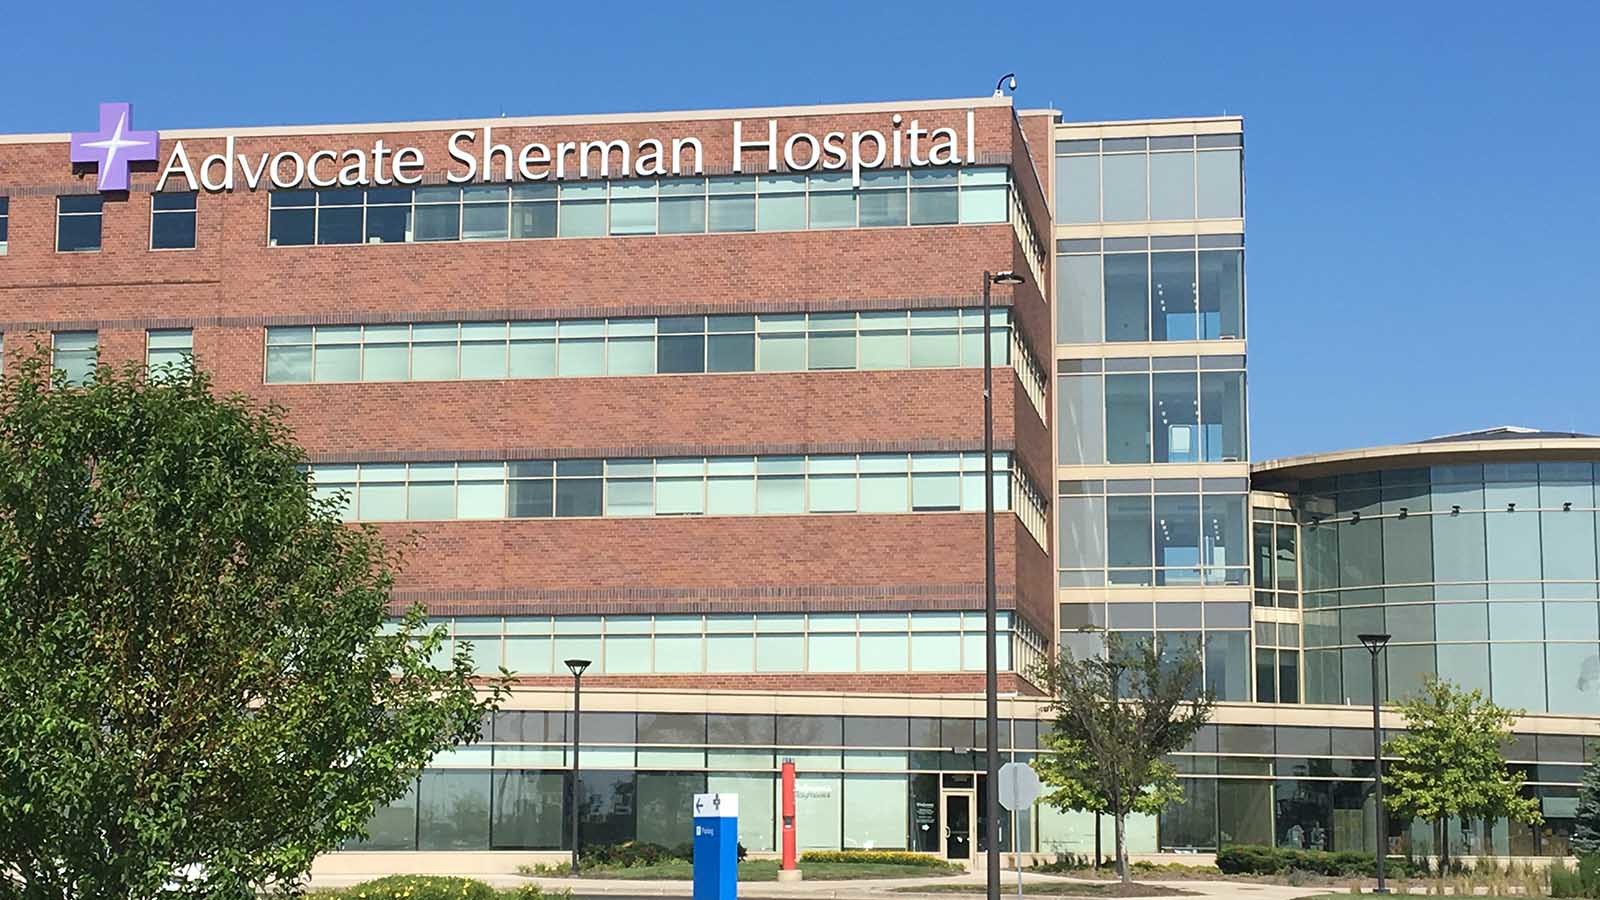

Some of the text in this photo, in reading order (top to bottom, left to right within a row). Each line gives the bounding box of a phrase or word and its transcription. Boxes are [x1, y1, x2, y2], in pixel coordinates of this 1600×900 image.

[155, 111, 976, 193] Advocate Sherman Hospital
